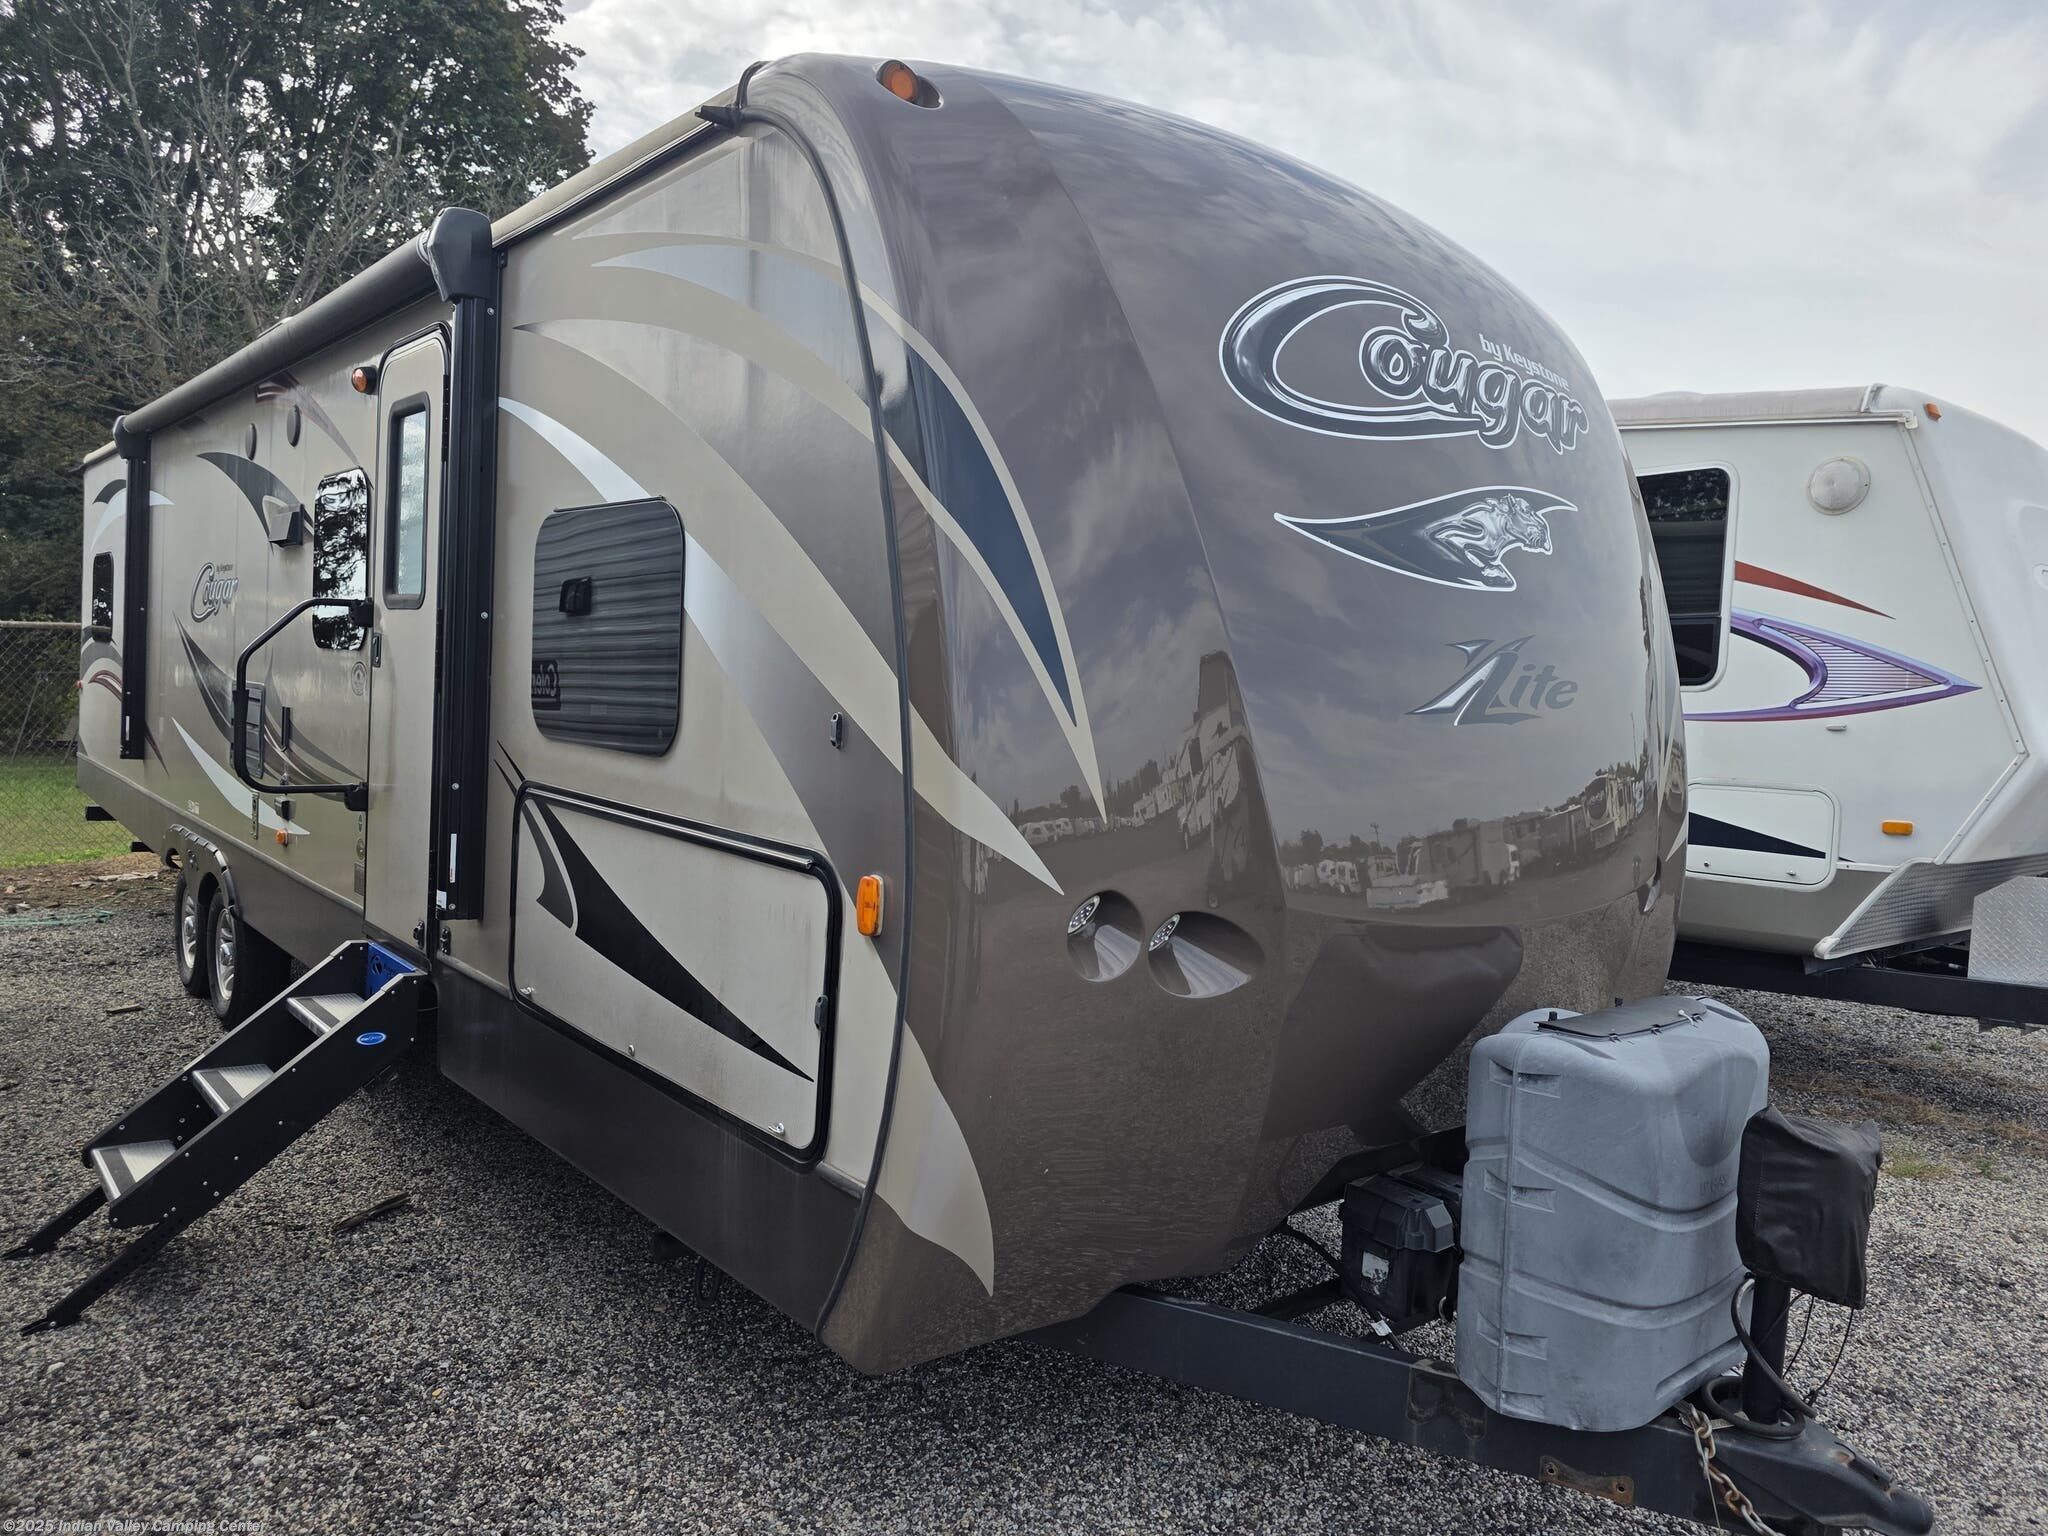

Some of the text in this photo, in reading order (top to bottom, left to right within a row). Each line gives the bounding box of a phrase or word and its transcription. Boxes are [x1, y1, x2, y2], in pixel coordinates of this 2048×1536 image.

[1218, 274, 1590, 455] Cougar
[1478, 332, 1570, 392] by Keystone
[191, 562, 240, 623] Cougar
